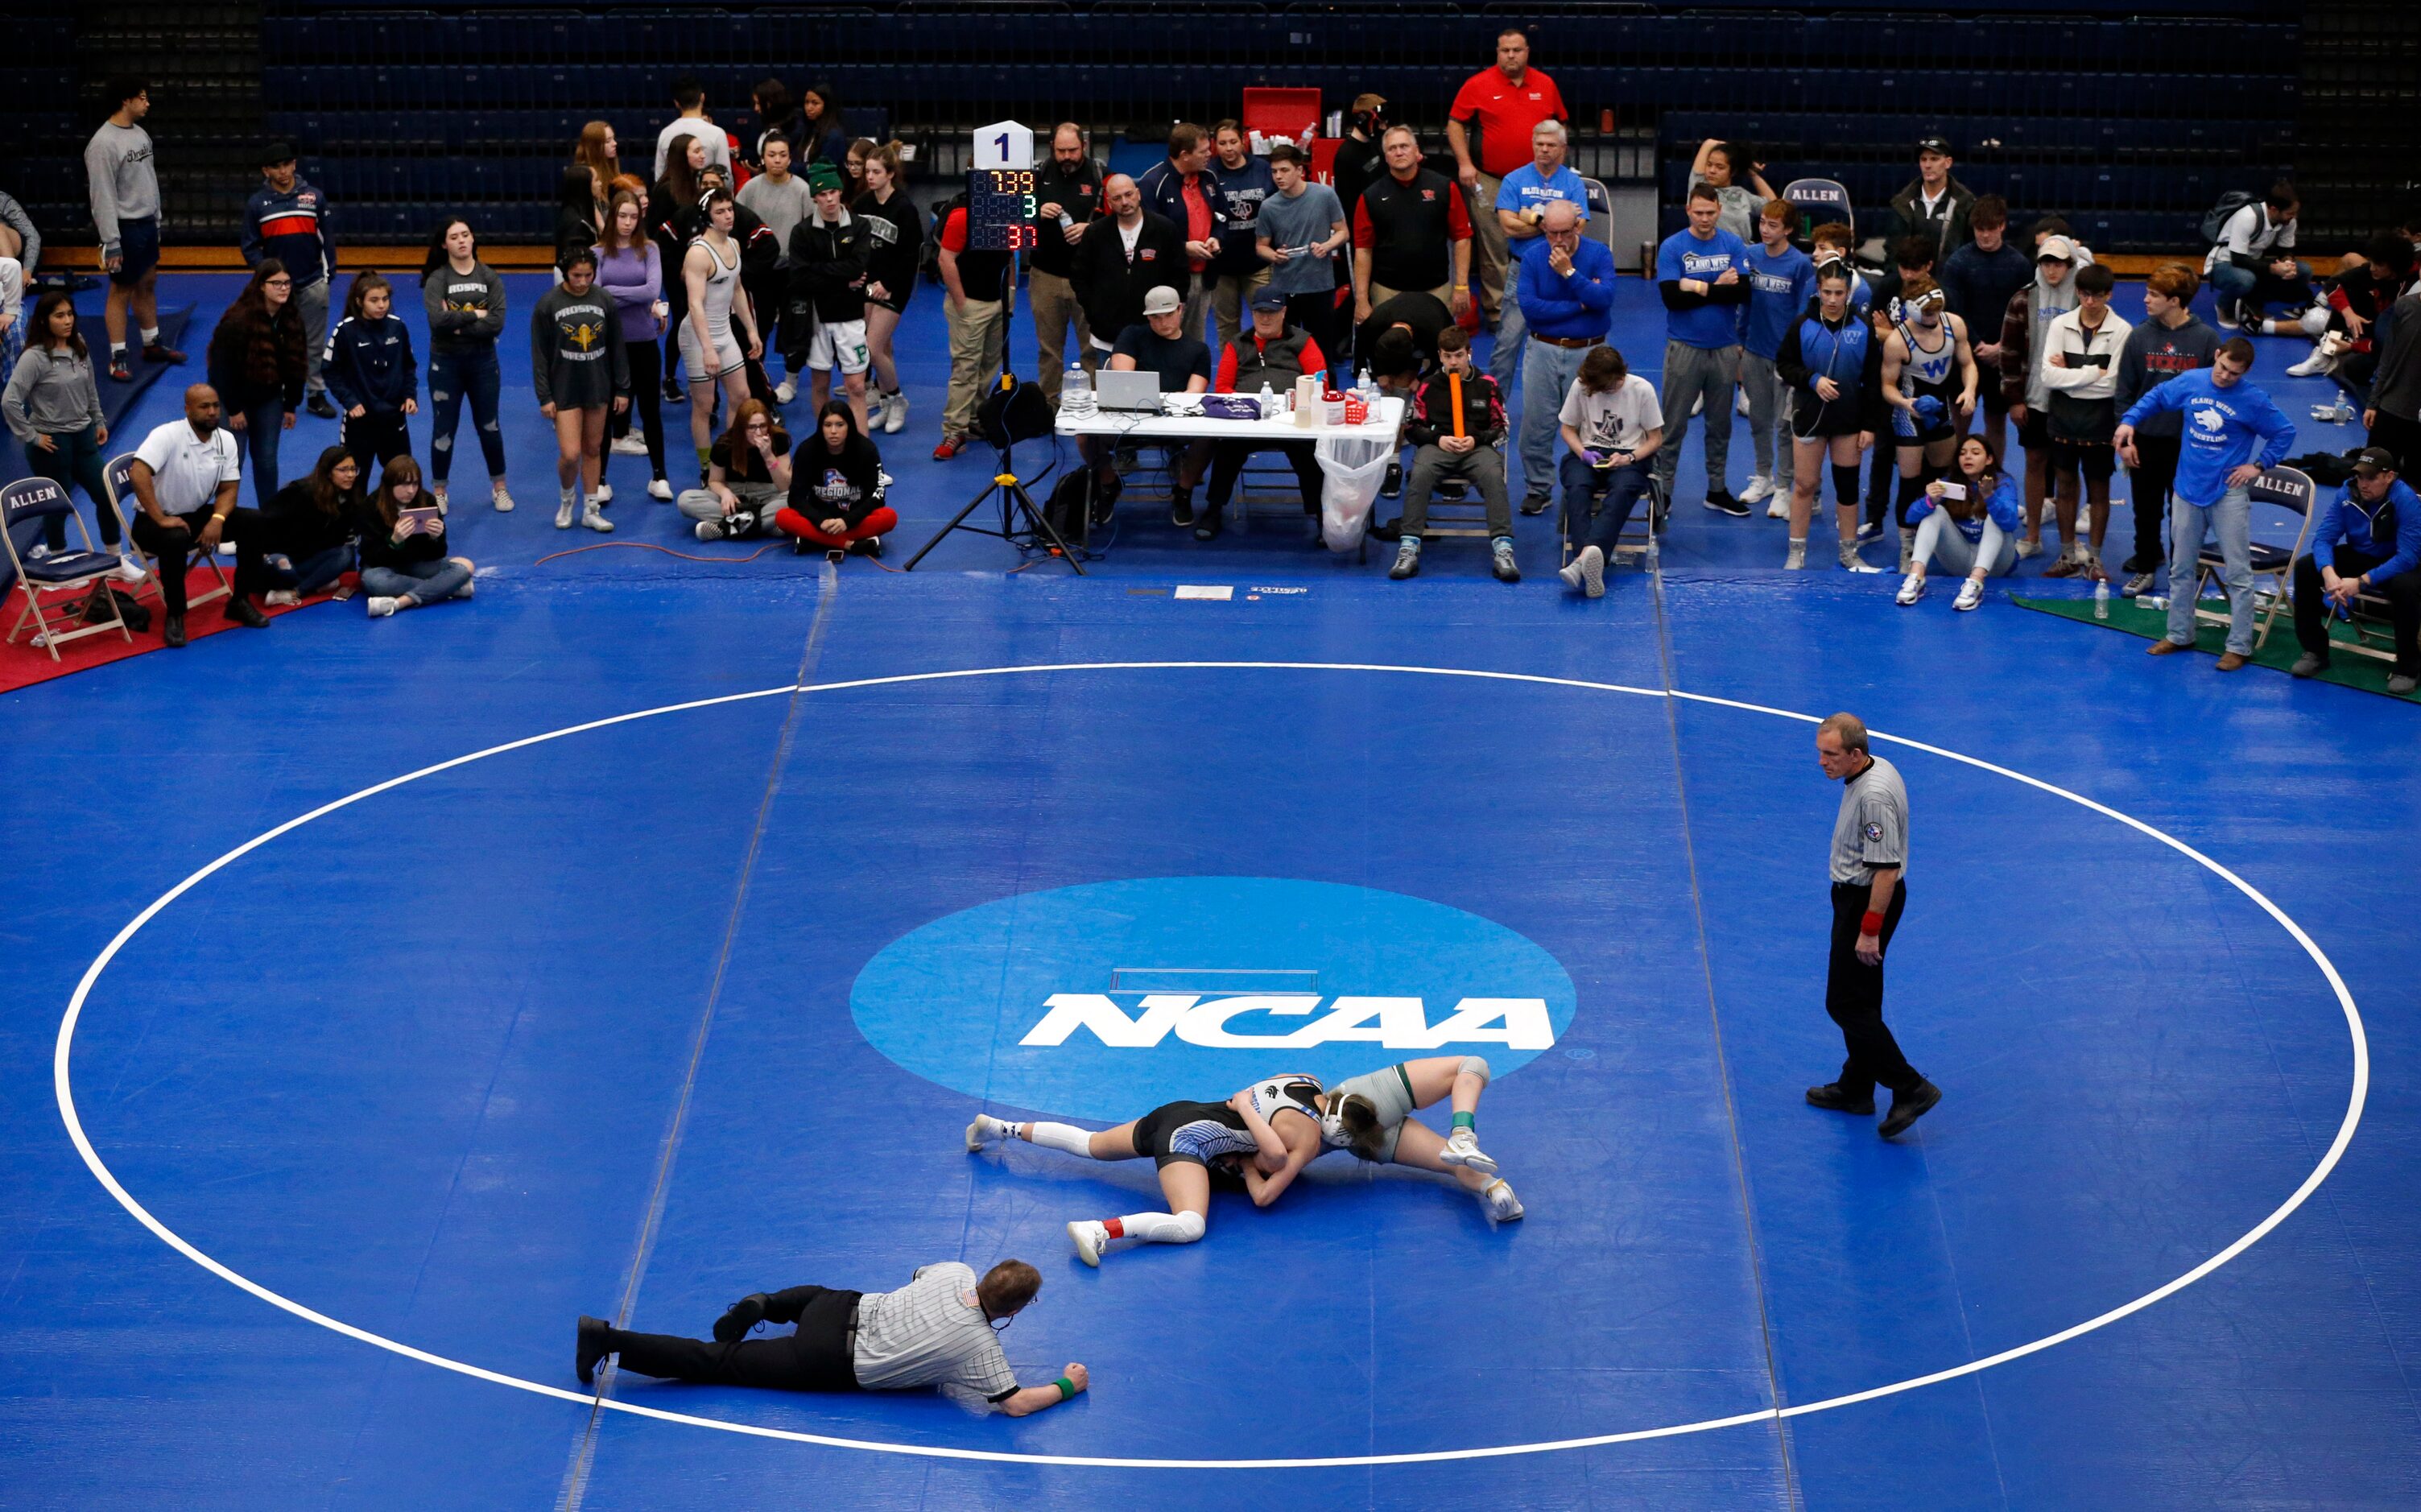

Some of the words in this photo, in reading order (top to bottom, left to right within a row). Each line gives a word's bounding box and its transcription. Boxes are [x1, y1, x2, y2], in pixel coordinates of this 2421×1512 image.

[994, 133, 1009, 162] 1
[990, 171, 1034, 195] 739
[1791, 189, 1840, 201] ALLEN
[1023, 195, 1037, 219] 3
[1009, 225, 1037, 249] 37
[1684, 258, 1712, 271] PLANO
[1710, 257, 1730, 268] WES
[448, 283, 488, 294] ROSPE
[1769, 278, 1792, 290] WEST
[1842, 329, 1861, 345] W
[854, 344, 866, 364] P
[1921, 356, 1950, 378] W
[2216, 400, 2236, 416] WEST
[813, 485, 861, 497] REGIONAL
[2254, 475, 2304, 497] ALLEN
[10, 486, 58, 509] ALLEN
[1018, 994, 1555, 1050] NCAA
